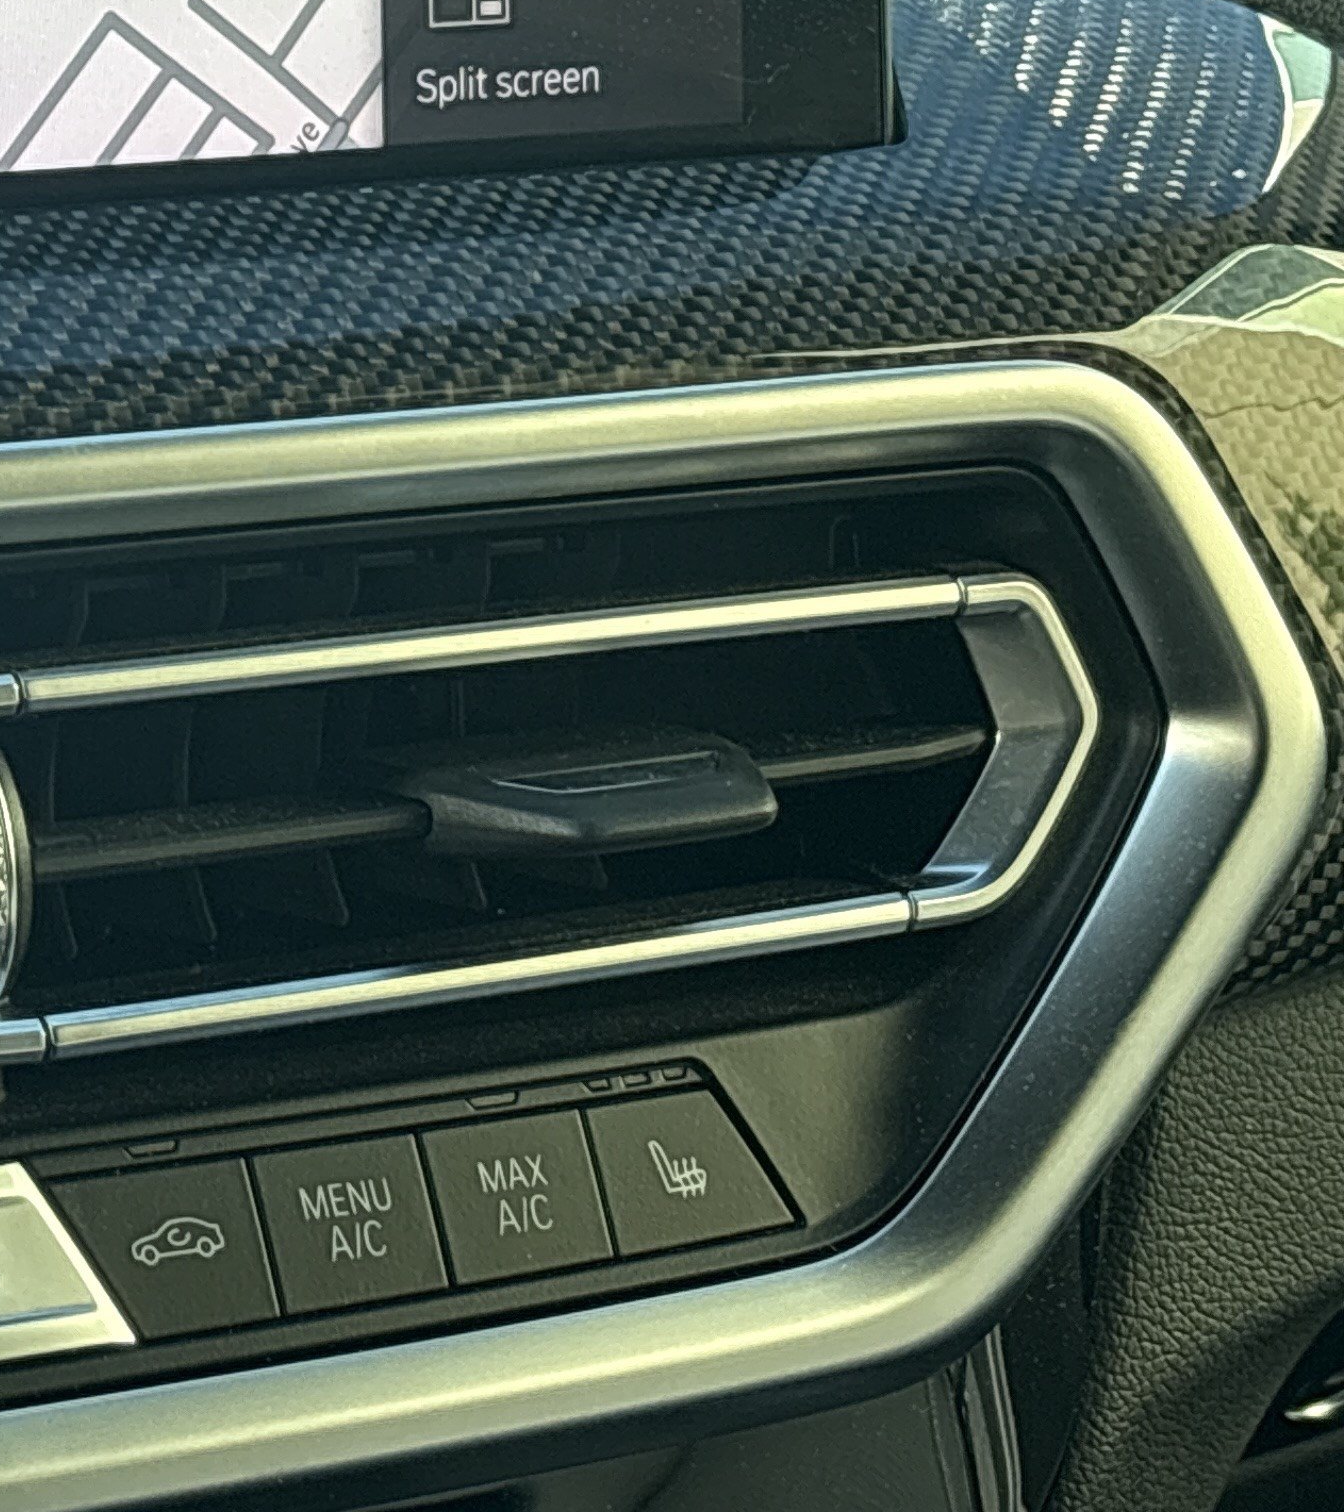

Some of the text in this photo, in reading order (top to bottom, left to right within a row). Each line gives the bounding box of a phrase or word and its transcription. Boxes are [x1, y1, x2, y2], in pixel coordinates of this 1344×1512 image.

[416, 65, 600, 109] Split screen
[477, 1154, 549, 1193] MAX
[298, 1177, 392, 1221] MENU
[499, 1193, 554, 1236] A/C
[331, 1219, 387, 1262] A/C
